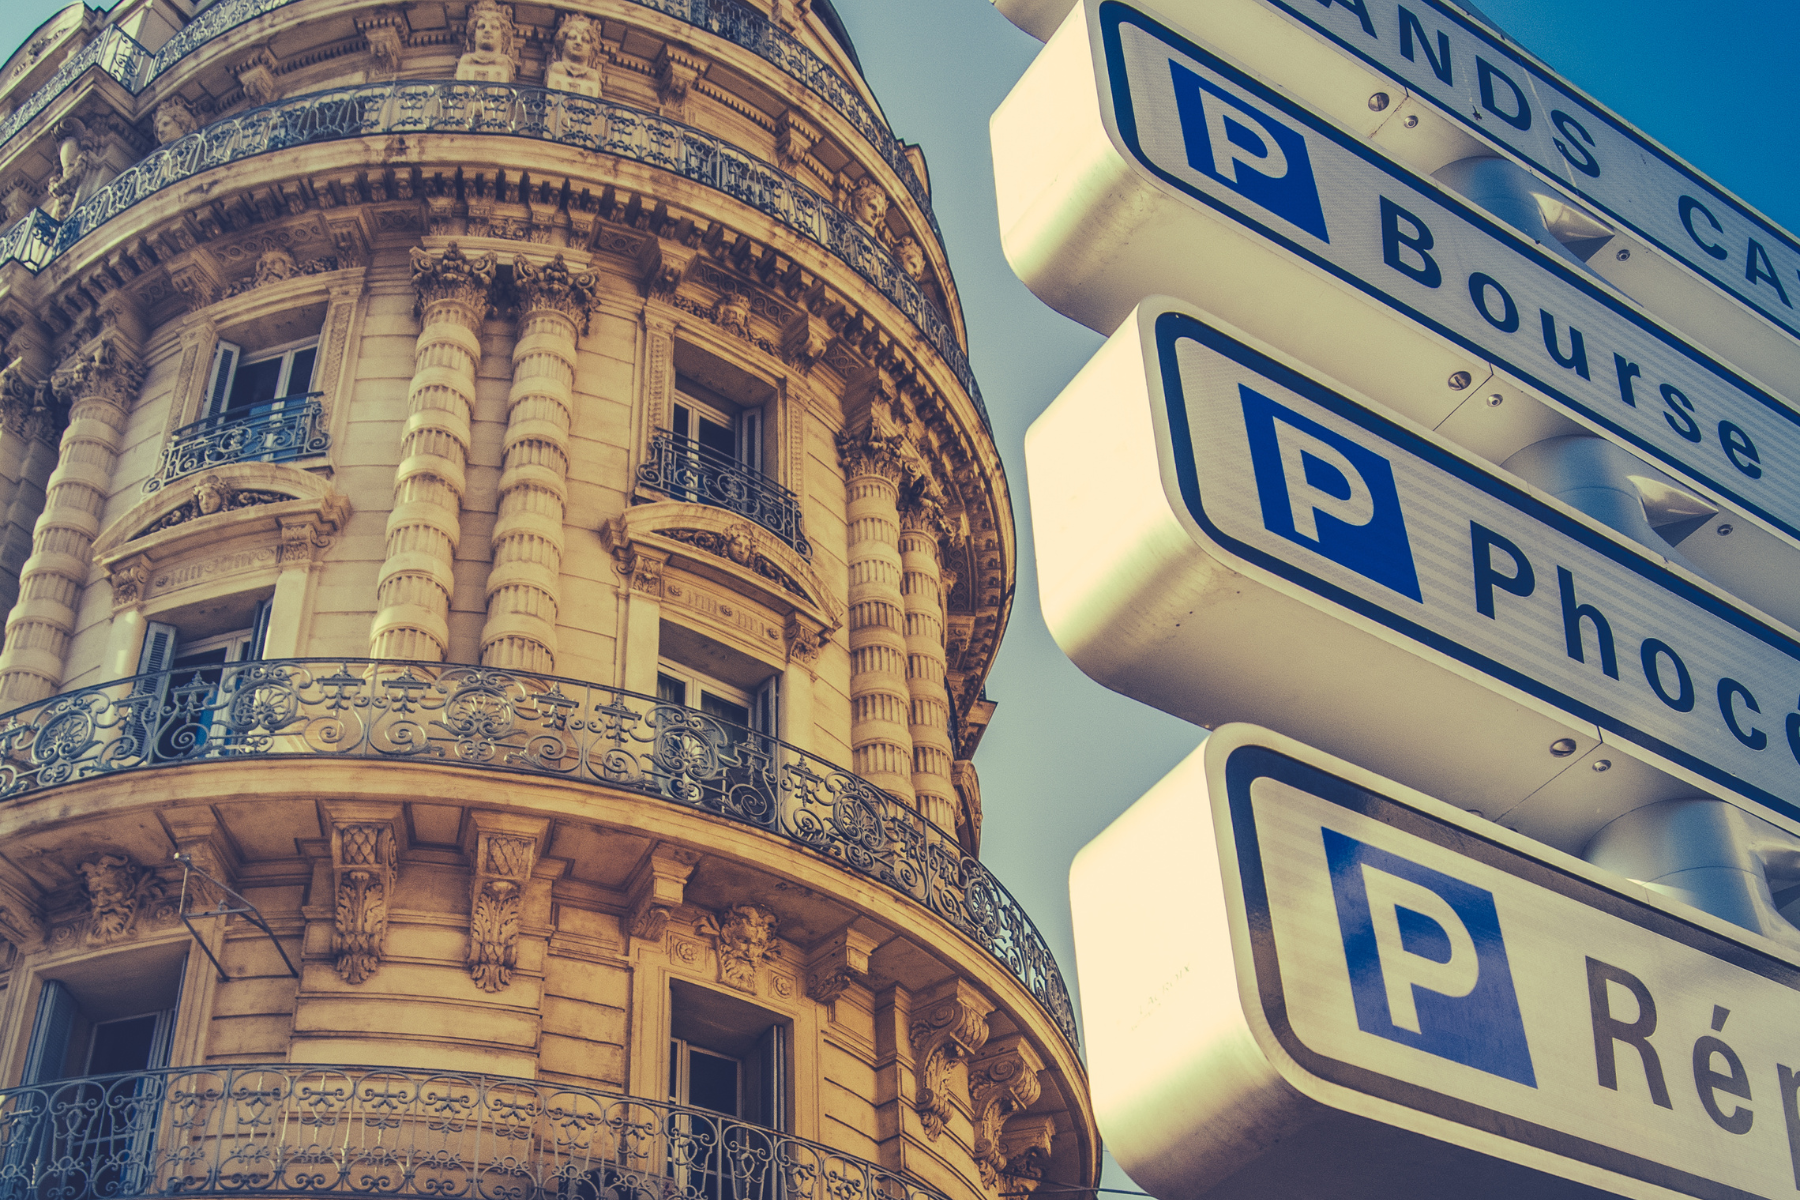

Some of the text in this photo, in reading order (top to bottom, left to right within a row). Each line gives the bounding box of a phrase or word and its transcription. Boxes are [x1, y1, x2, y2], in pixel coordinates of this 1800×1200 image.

[1198, 86, 1763, 480] P Bourse
[1678, 194, 1800, 311] CA
[1272, 415, 1375, 544] P
[1360, 862, 1480, 1035] P
